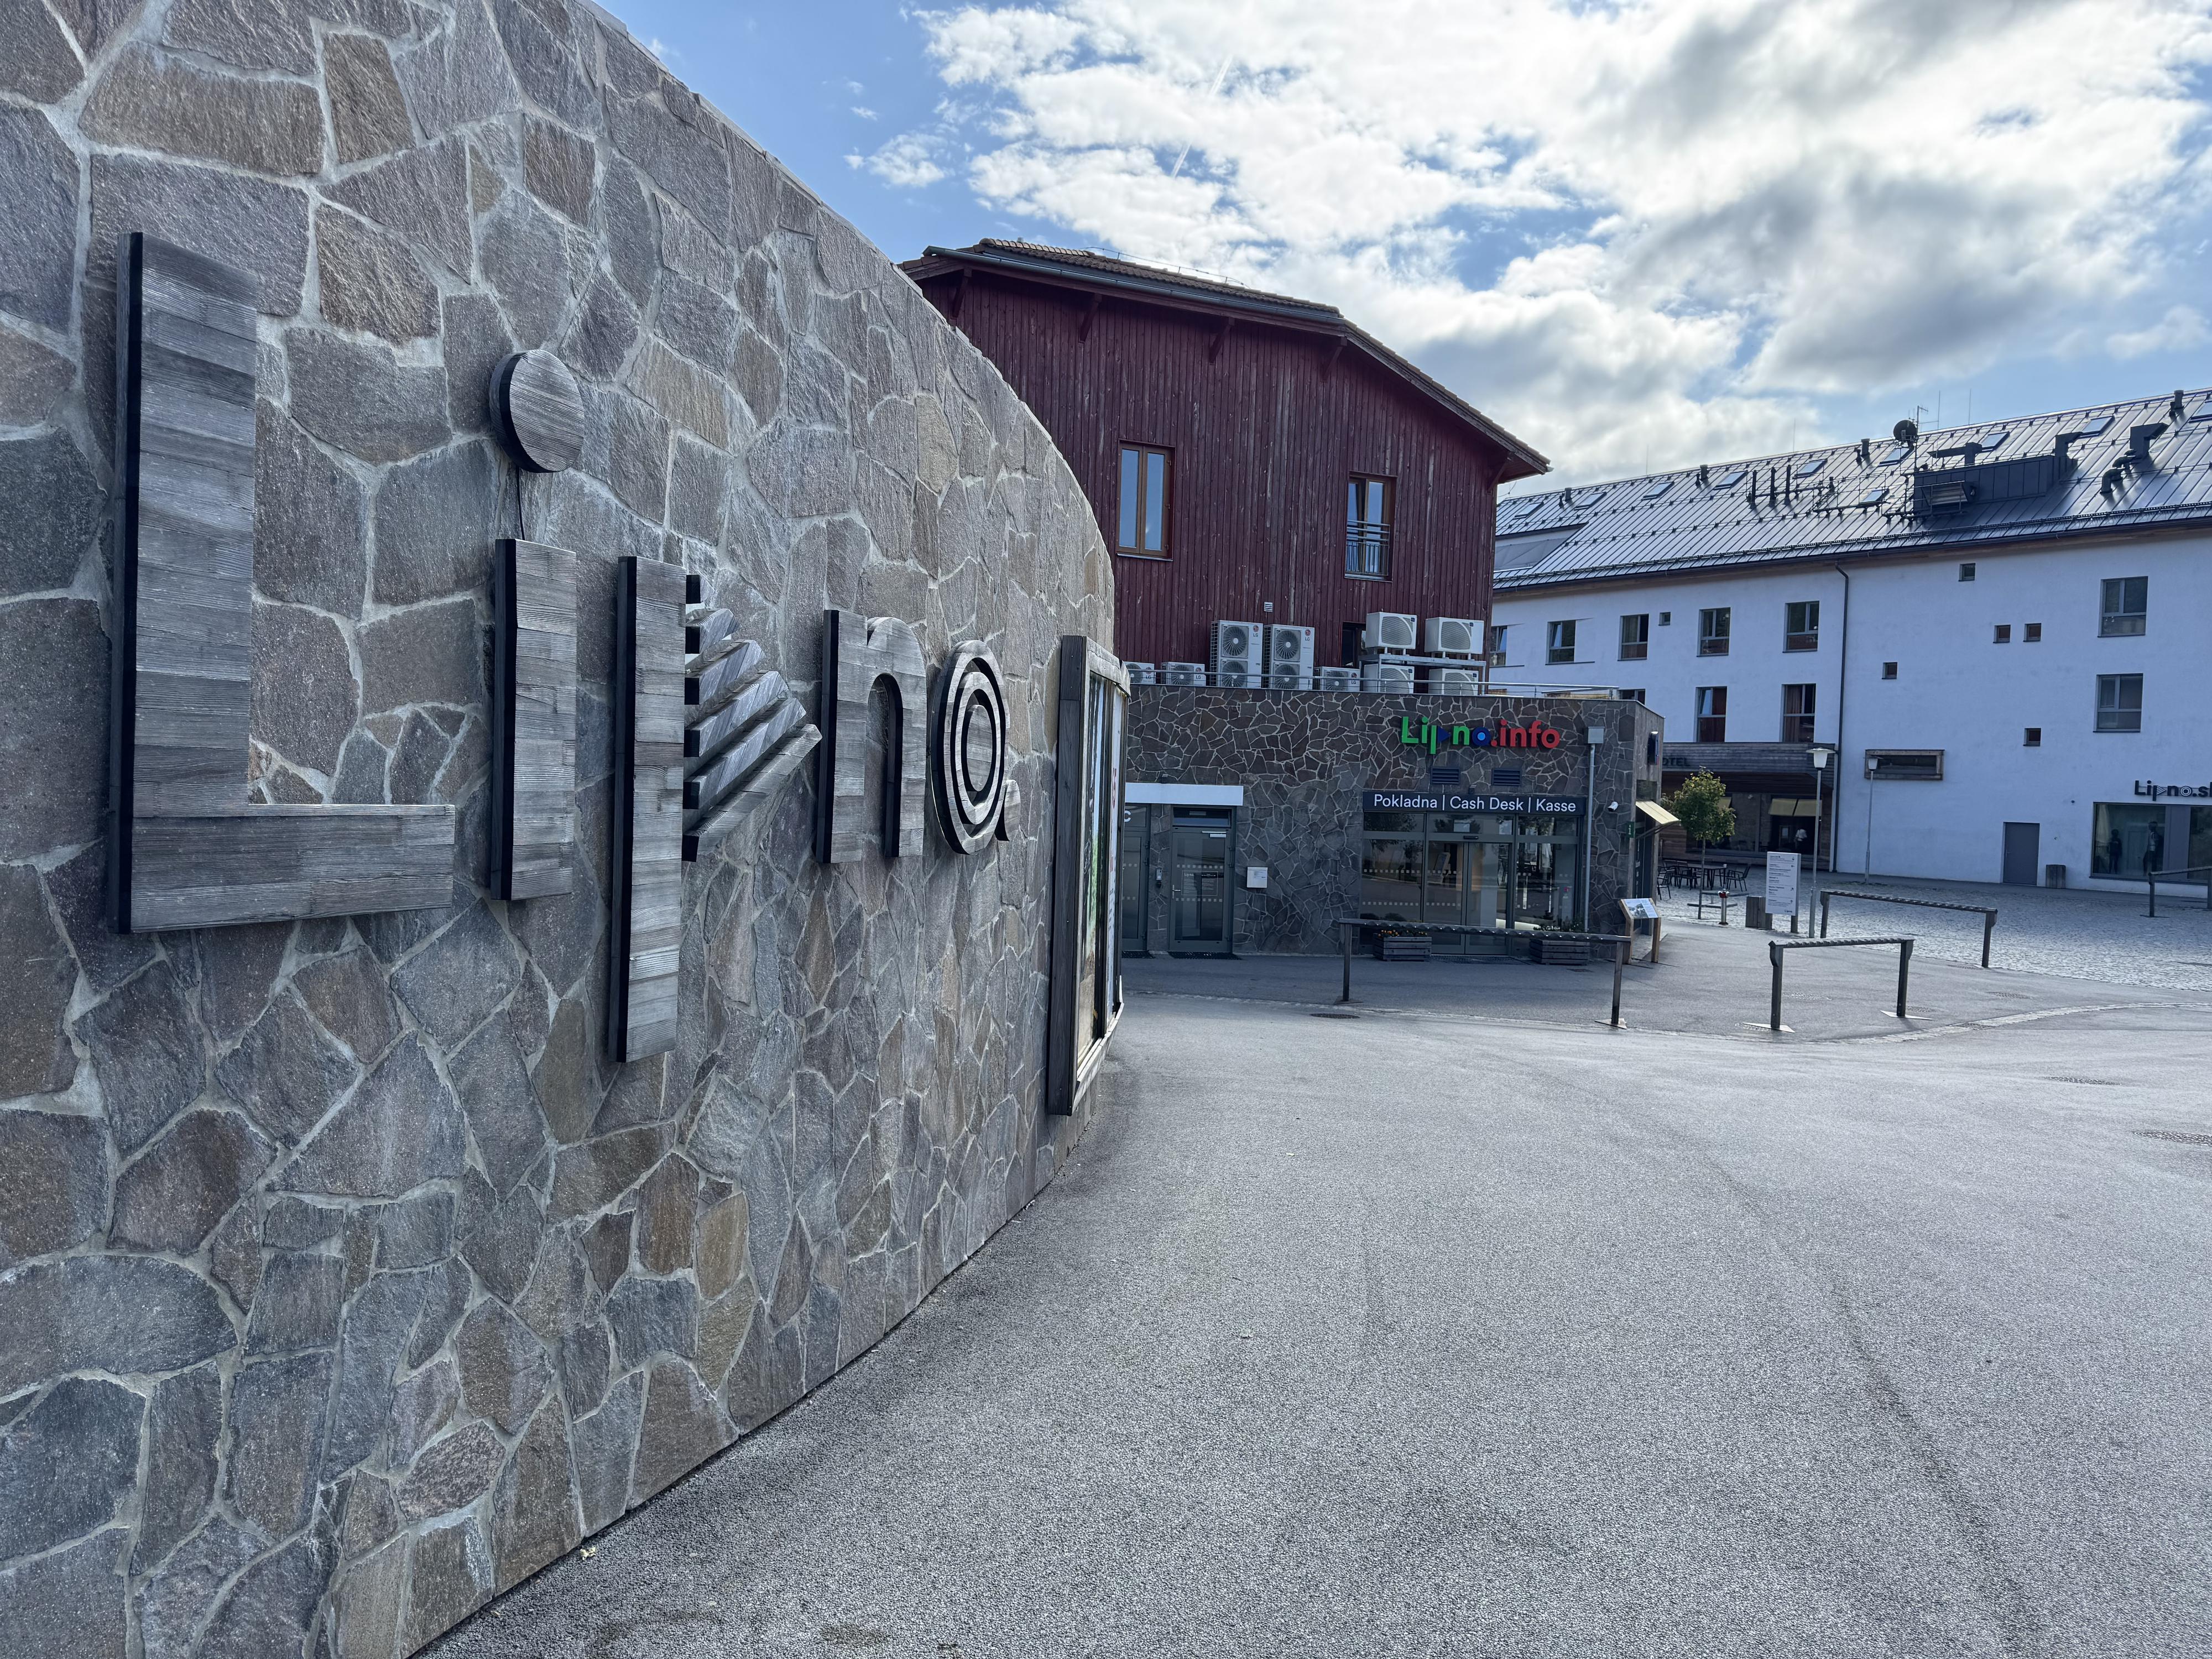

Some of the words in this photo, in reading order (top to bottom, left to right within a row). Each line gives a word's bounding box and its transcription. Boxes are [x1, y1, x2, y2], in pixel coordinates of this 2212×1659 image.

[1401, 716, 1561, 755] Lipno.info
[1662, 757, 1691, 766] OTEL
[2135, 780, 2212, 801] Lipno.s
[1374, 794, 1437, 808] Pokladna
[1450, 796, 1484, 810] Cash
[1489, 797, 1524, 811] Desk
[1536, 799, 1576, 812] Kasse
[1124, 810, 1131, 822] C
